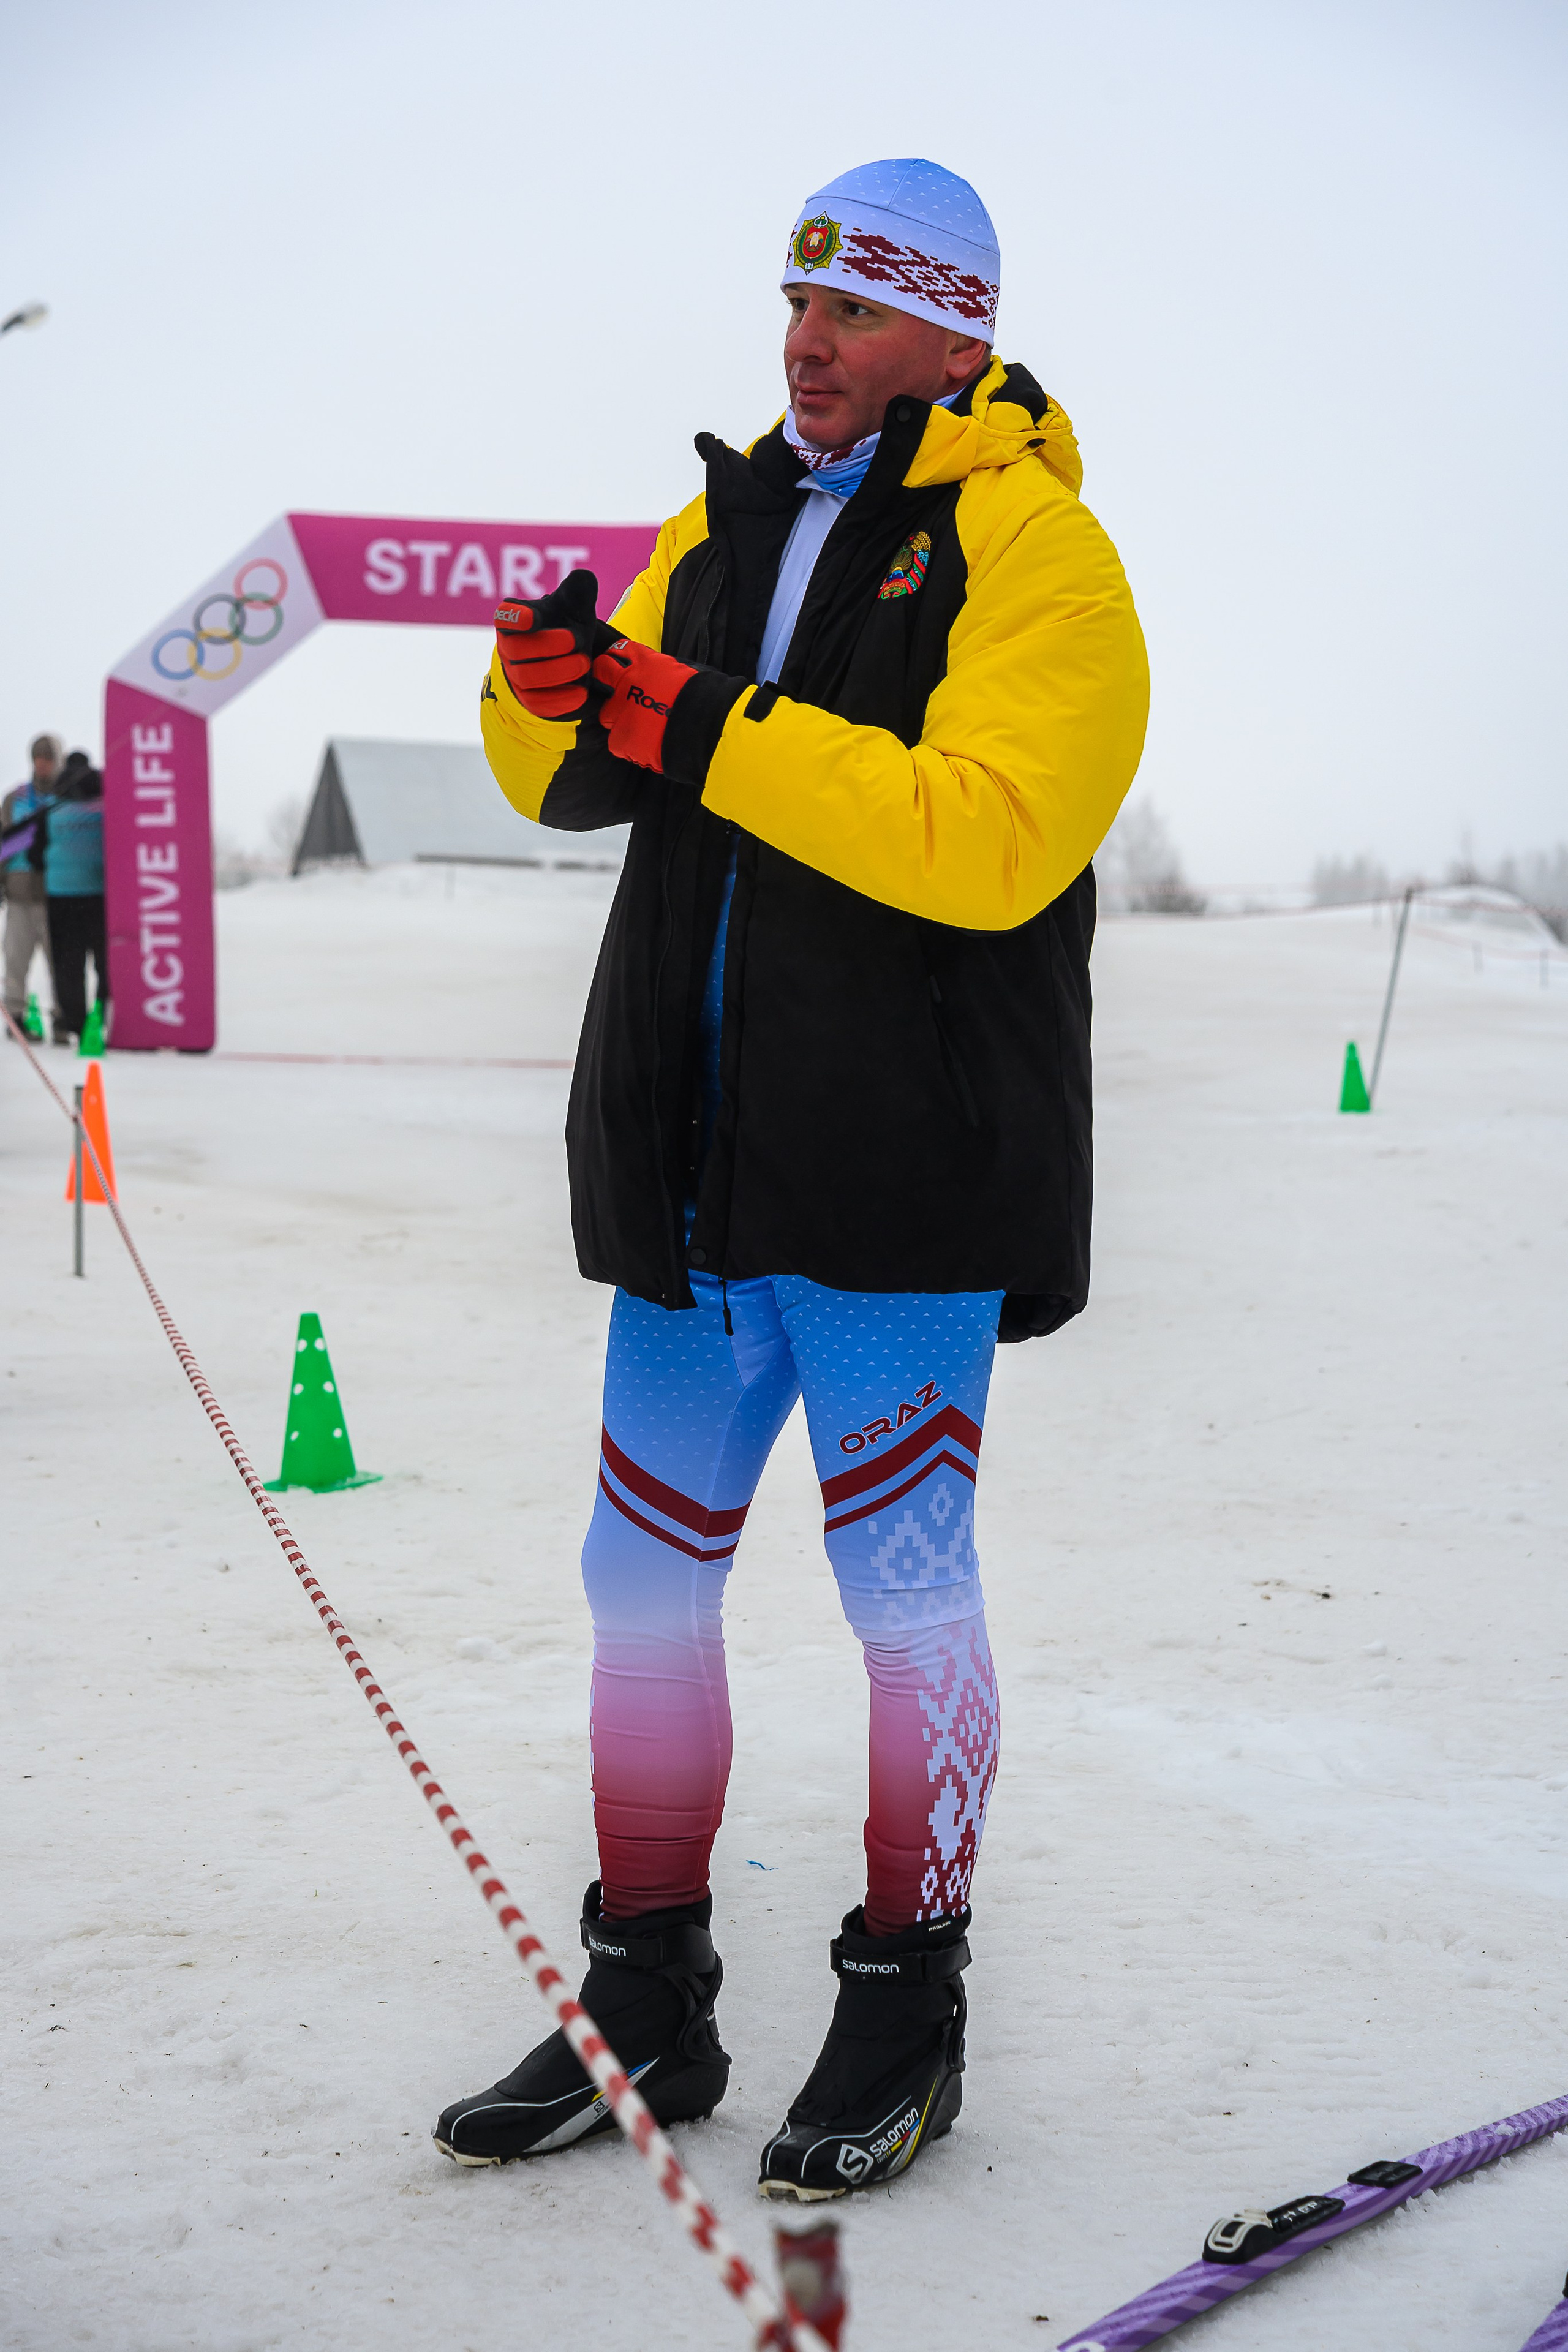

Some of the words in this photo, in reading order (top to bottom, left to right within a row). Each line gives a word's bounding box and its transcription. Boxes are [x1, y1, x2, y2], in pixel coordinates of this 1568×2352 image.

[364, 538, 589, 598] START
[132, 722, 176, 829] LIFE
[136, 842, 184, 1027] ACTIVE
[839, 1380, 942, 1454] ORAZ
